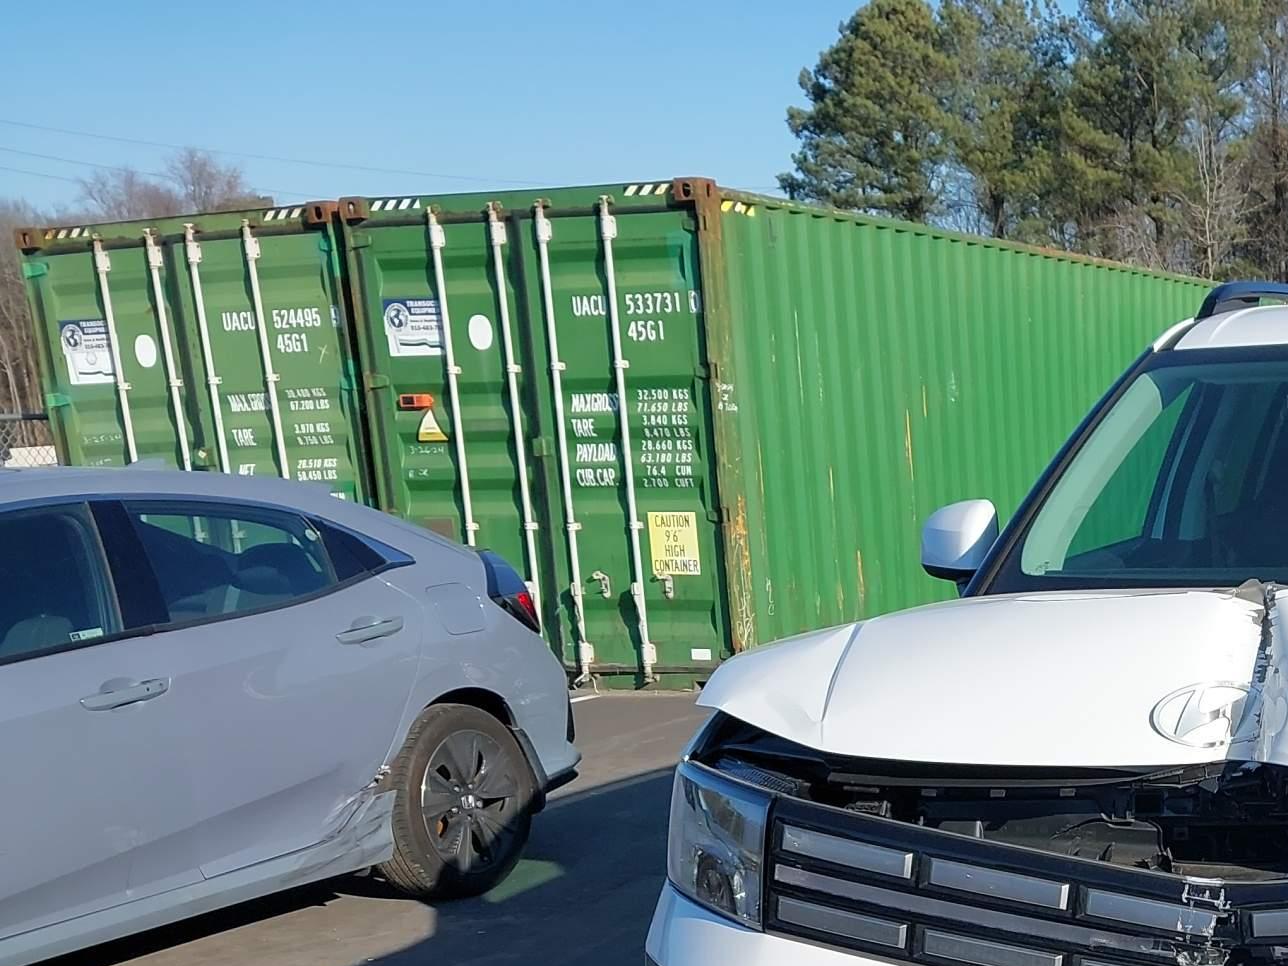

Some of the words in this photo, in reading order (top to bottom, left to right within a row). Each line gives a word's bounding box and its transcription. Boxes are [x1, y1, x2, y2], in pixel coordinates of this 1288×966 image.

[571, 296, 607, 316] UACU
[625, 292, 681, 314] 533731
[222, 311, 256, 331] UACU
[272, 308, 321, 329] 524495
[627, 320, 665, 341] 45G1
[276, 333, 309, 353] 45G1
[637, 389, 669, 400] 32.500
[672, 389, 689, 400] KGS
[290, 400, 314, 411] 67.200
[315, 399, 330, 410] LBS
[637, 402, 668, 412] 71.650
[671, 402, 688, 412] LBS
[642, 414, 668, 425] 3.840
[671, 414, 688, 425] KGS
[315, 423, 331, 433] KGS
[570, 418, 598, 437] TARE
[673, 428, 691, 438] LBS
[231, 429, 257, 447] TARE
[319, 435, 334, 445] LBS
[641, 440, 673, 451] 28.660
[676, 440, 693, 451] KGS
[575, 443, 617, 463] PAYLOAD
[640, 453, 672, 464] 63.180
[675, 453, 693, 464] LBS
[323, 458, 338, 468] KGS
[323, 469, 338, 480] LBS
[646, 466, 666, 476] 76.4
[643, 478, 669, 488] 2.700
[654, 514, 690, 528] CAUTION
[664, 544, 686, 557] HIGH
[654, 559, 699, 573] CONTAINER
